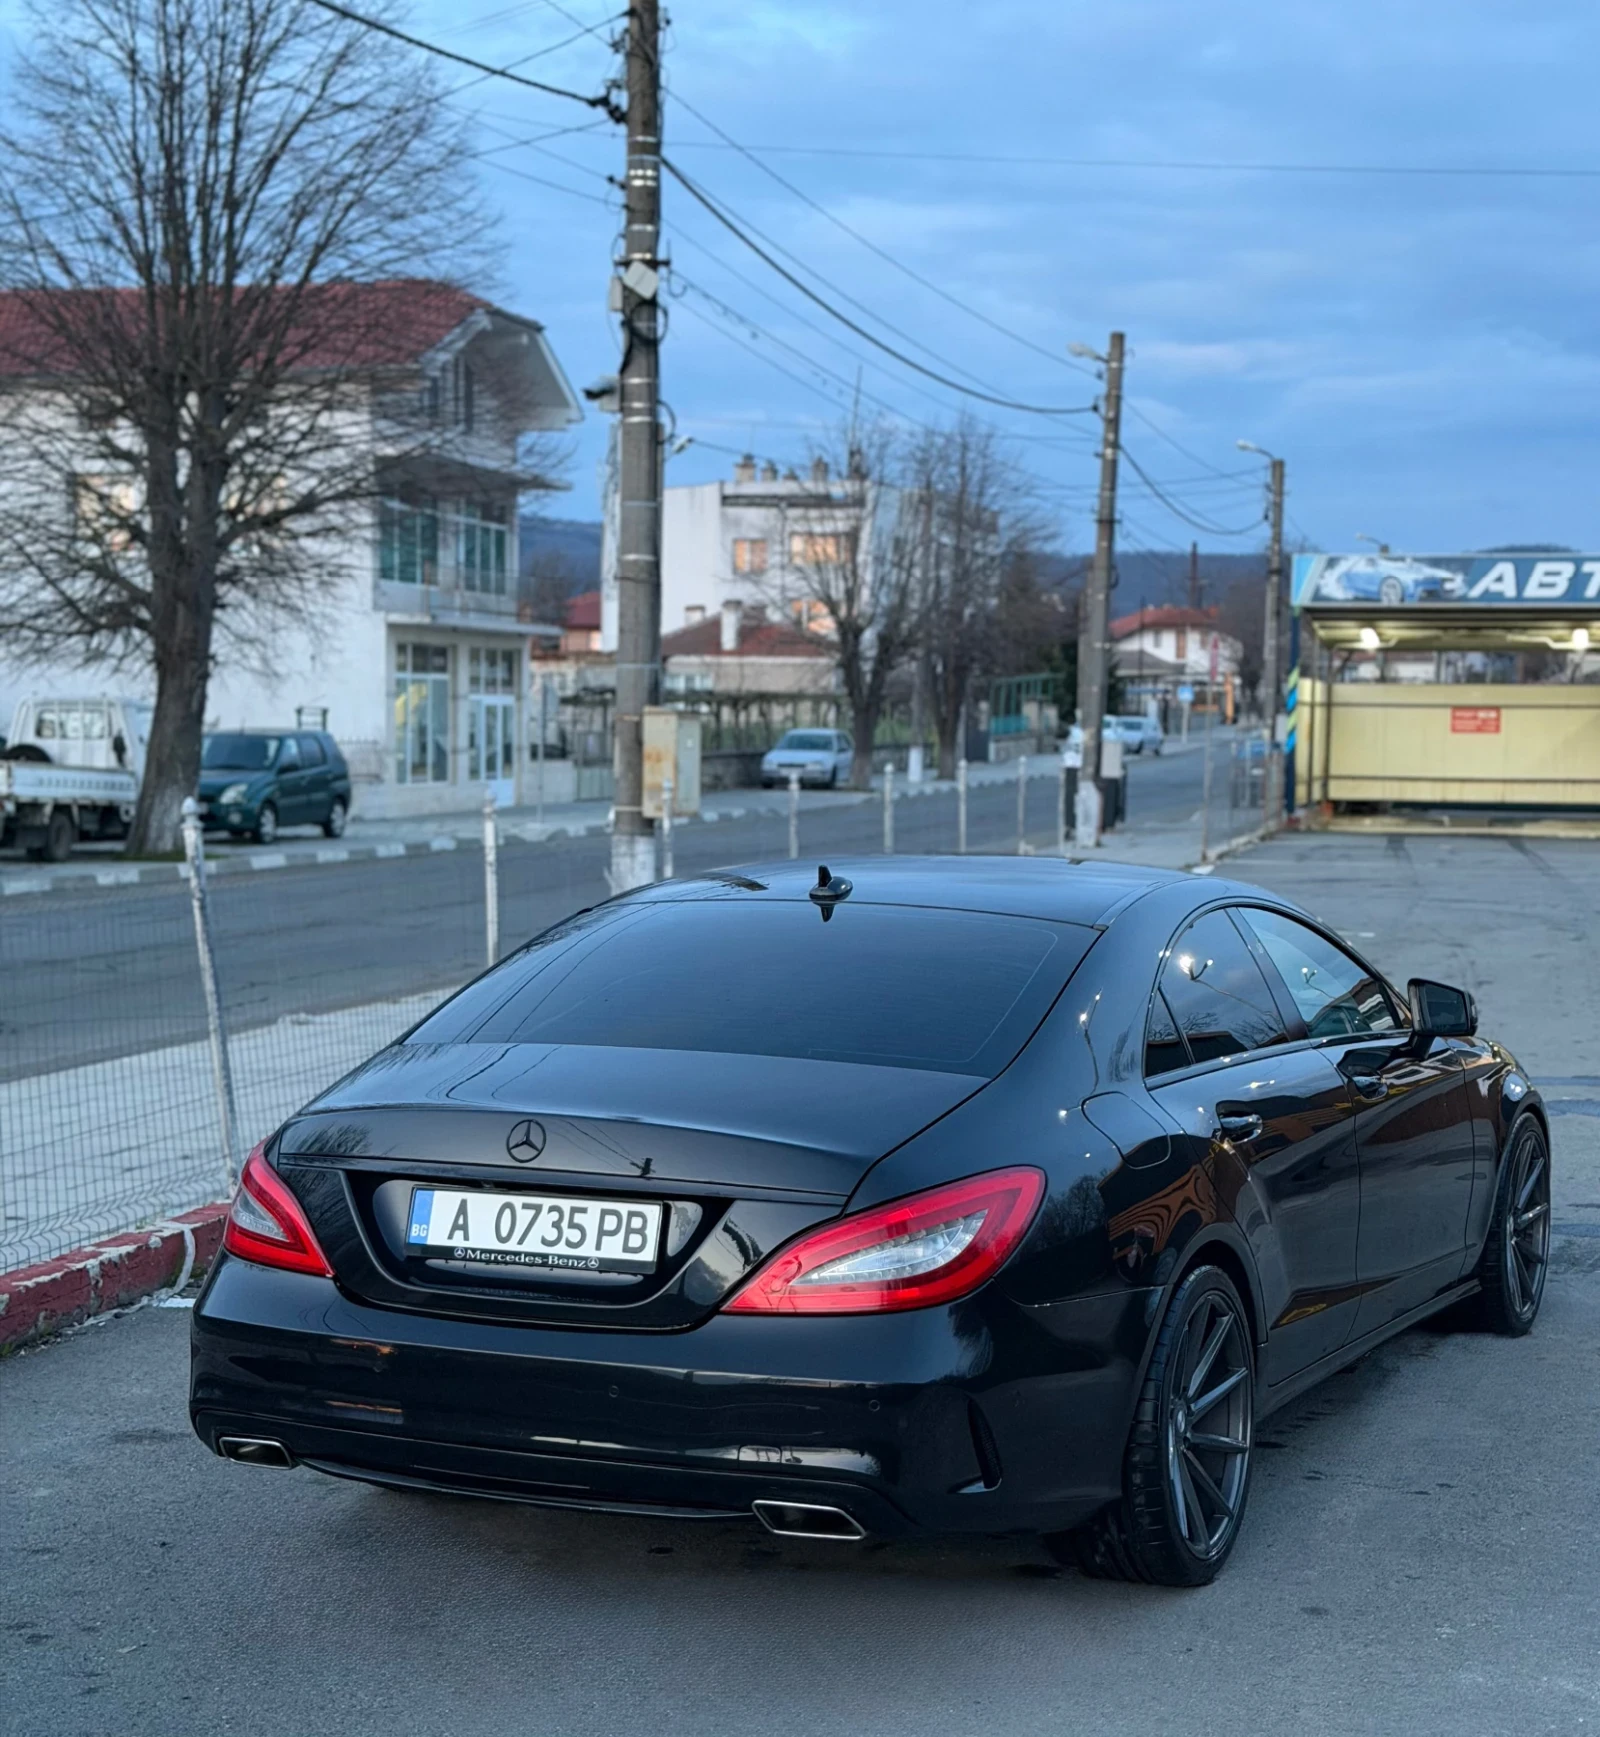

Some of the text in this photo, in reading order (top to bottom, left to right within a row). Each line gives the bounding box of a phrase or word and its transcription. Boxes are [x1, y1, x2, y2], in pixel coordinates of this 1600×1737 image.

[411, 1224, 428, 1237] BG
[447, 1198, 648, 1254] A 0735 PB
[466, 1249, 587, 1268] Mercedes-Benz
